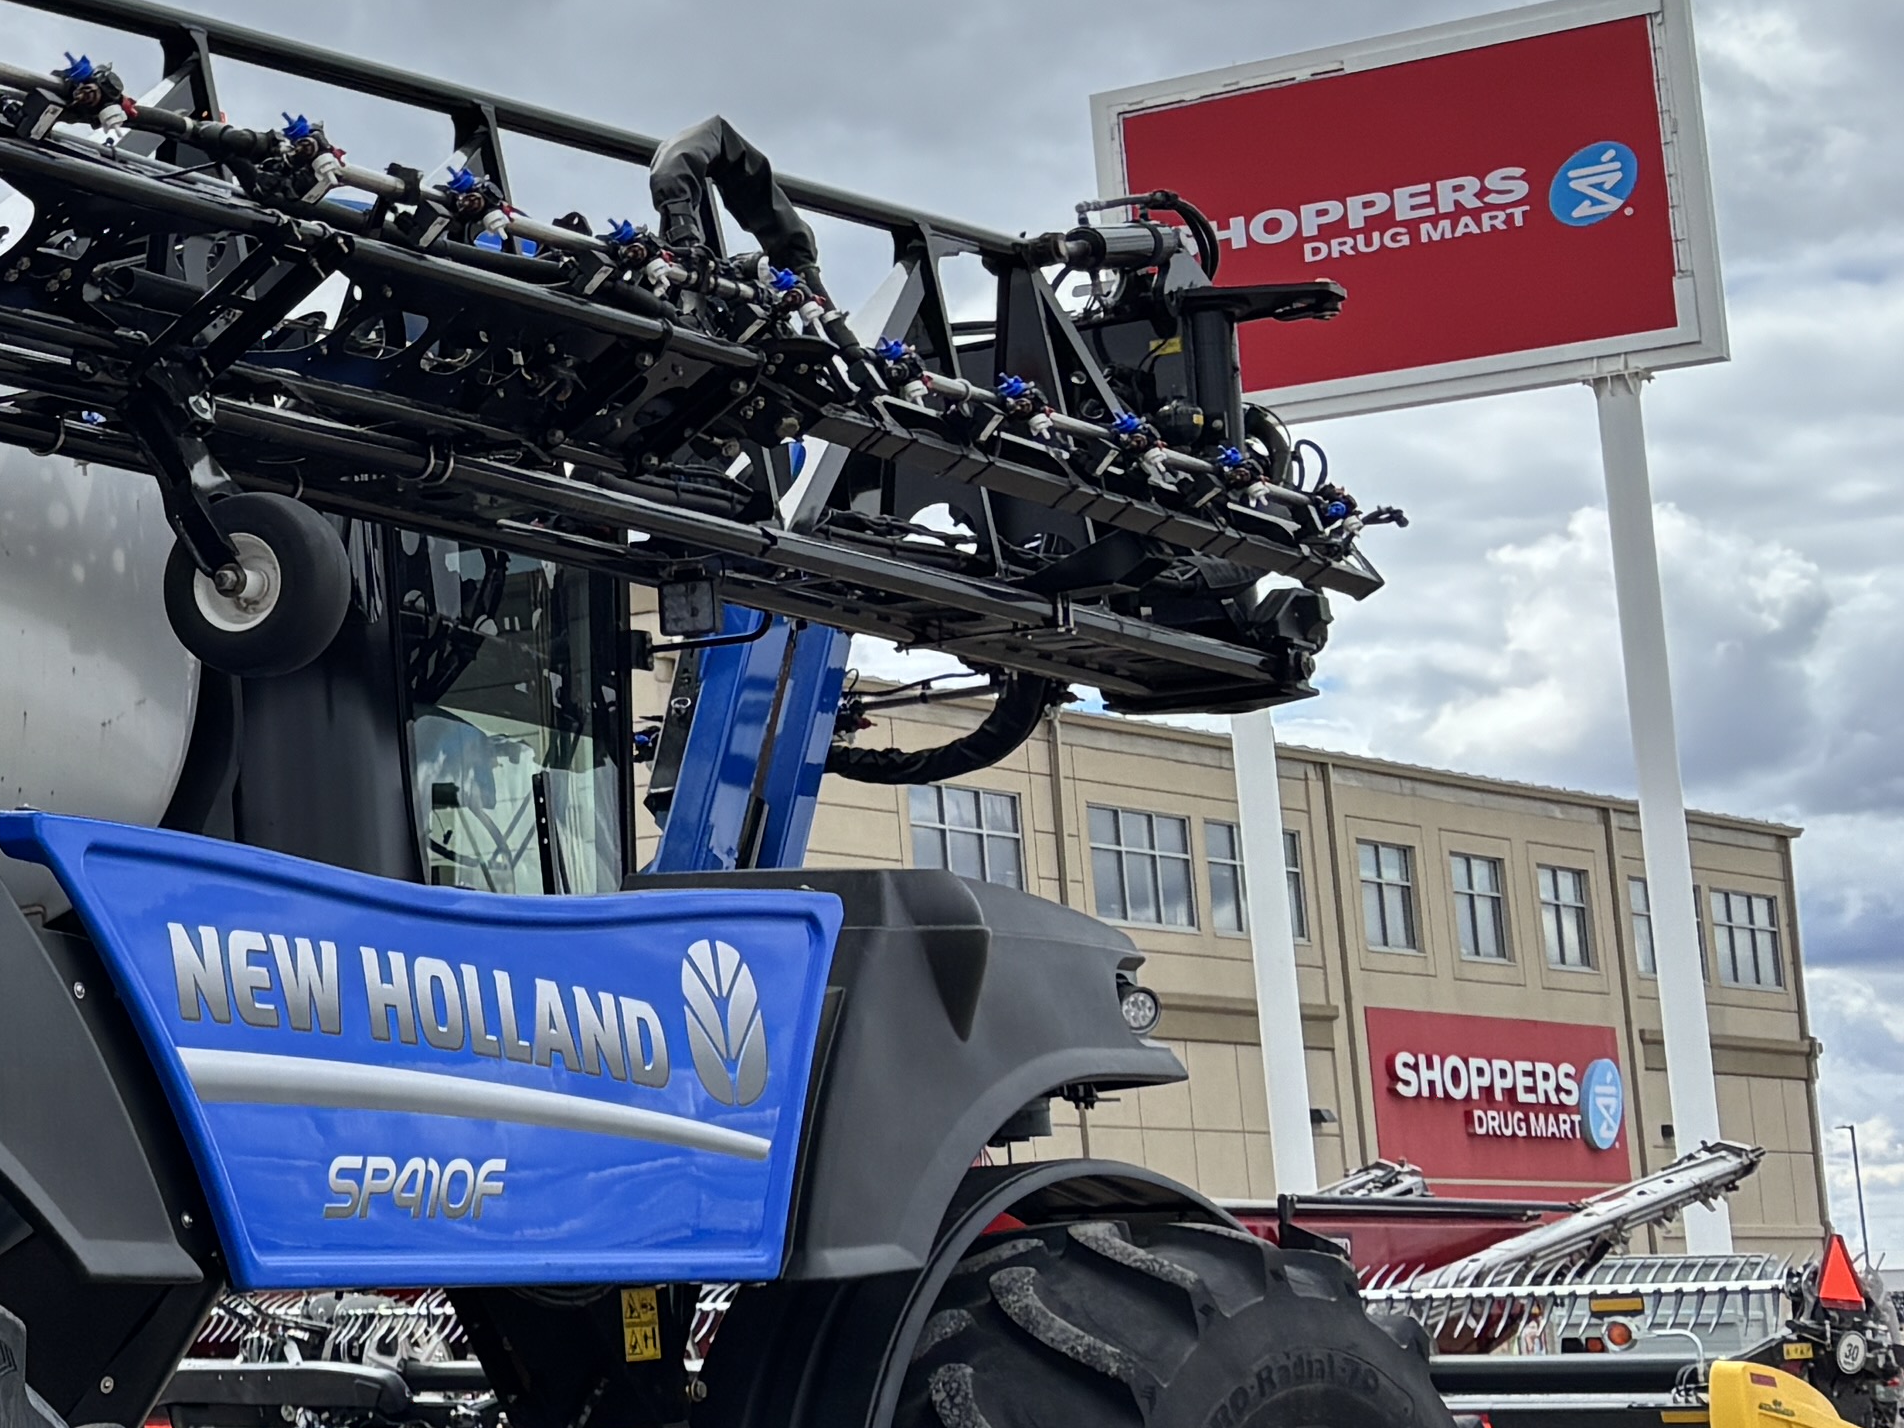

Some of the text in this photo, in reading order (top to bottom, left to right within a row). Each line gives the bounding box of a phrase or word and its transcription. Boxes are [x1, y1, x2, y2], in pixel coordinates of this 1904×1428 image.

[1303, 205, 1531, 264] DRUG MART
[166, 921, 670, 1089] NEW HOLLAND
[1393, 1051, 1580, 1106] SHOPPERS
[1472, 1108, 1583, 1140] DRUG MART
[322, 1155, 508, 1221] SP410F
[1844, 1342, 1860, 1362] 30
